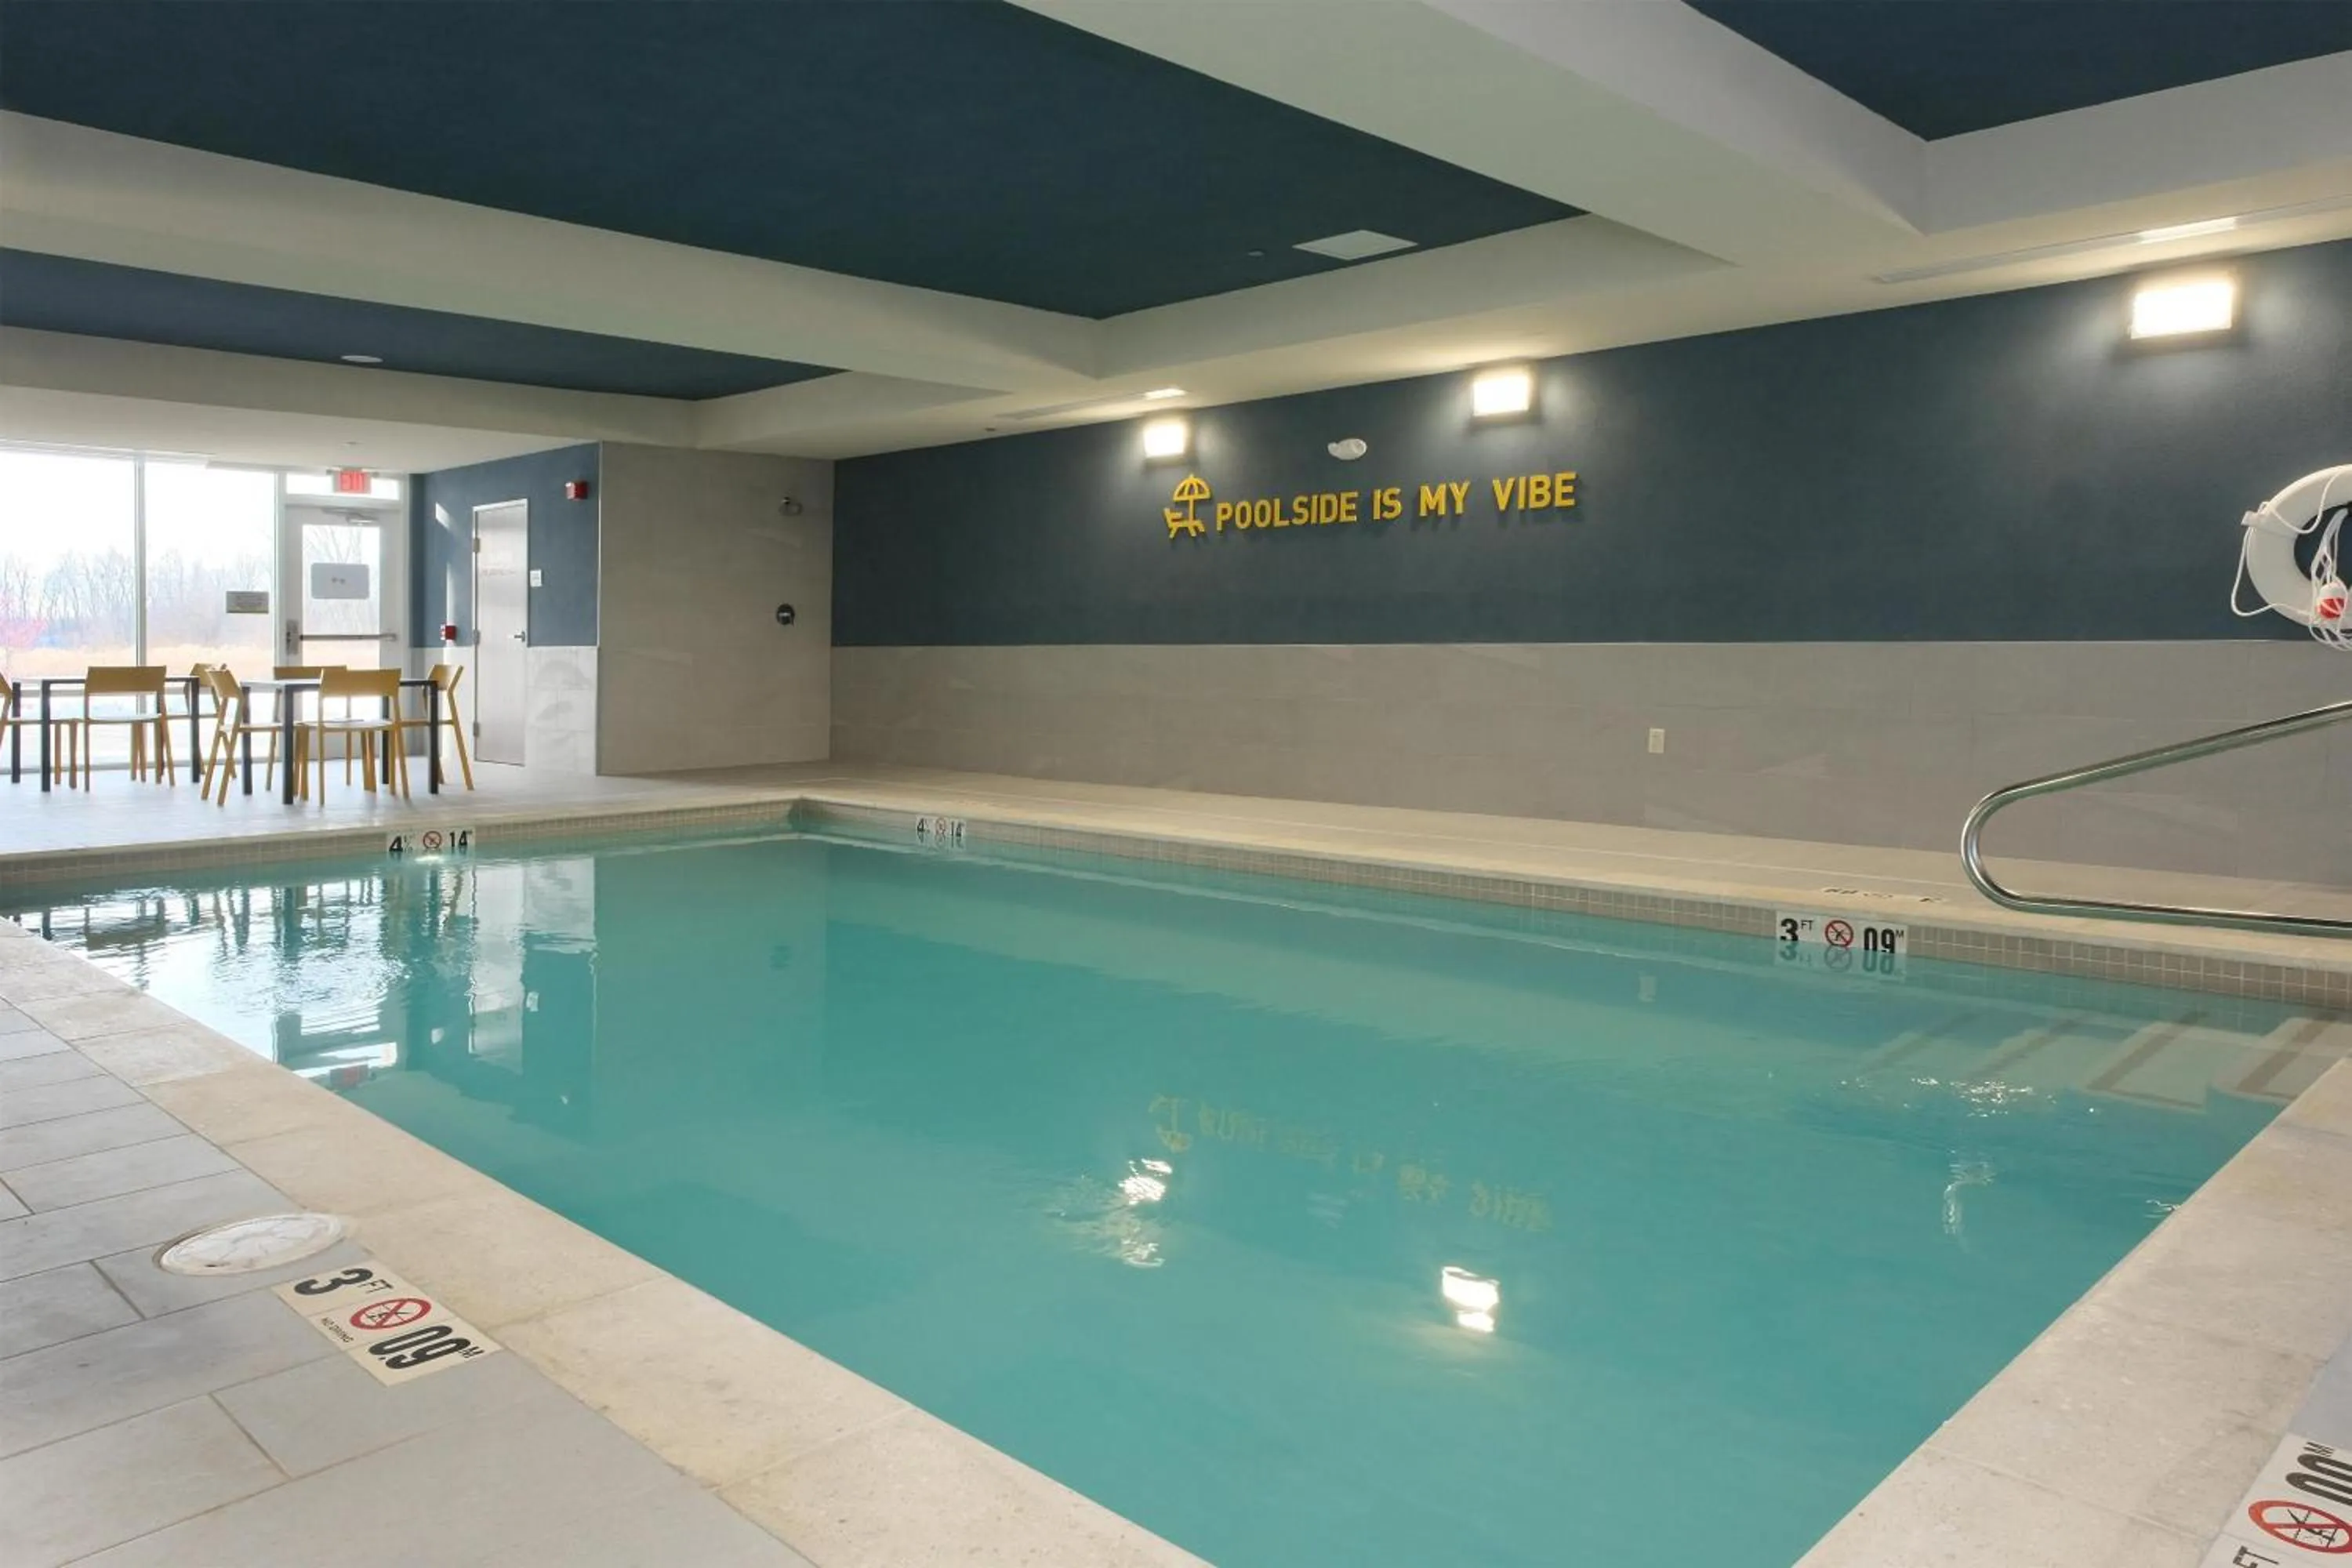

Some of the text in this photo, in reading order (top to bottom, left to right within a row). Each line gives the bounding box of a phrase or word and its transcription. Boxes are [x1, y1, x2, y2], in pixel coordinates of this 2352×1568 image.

[1215, 471, 1577, 531] POOLSIDE IS MY VIBE
